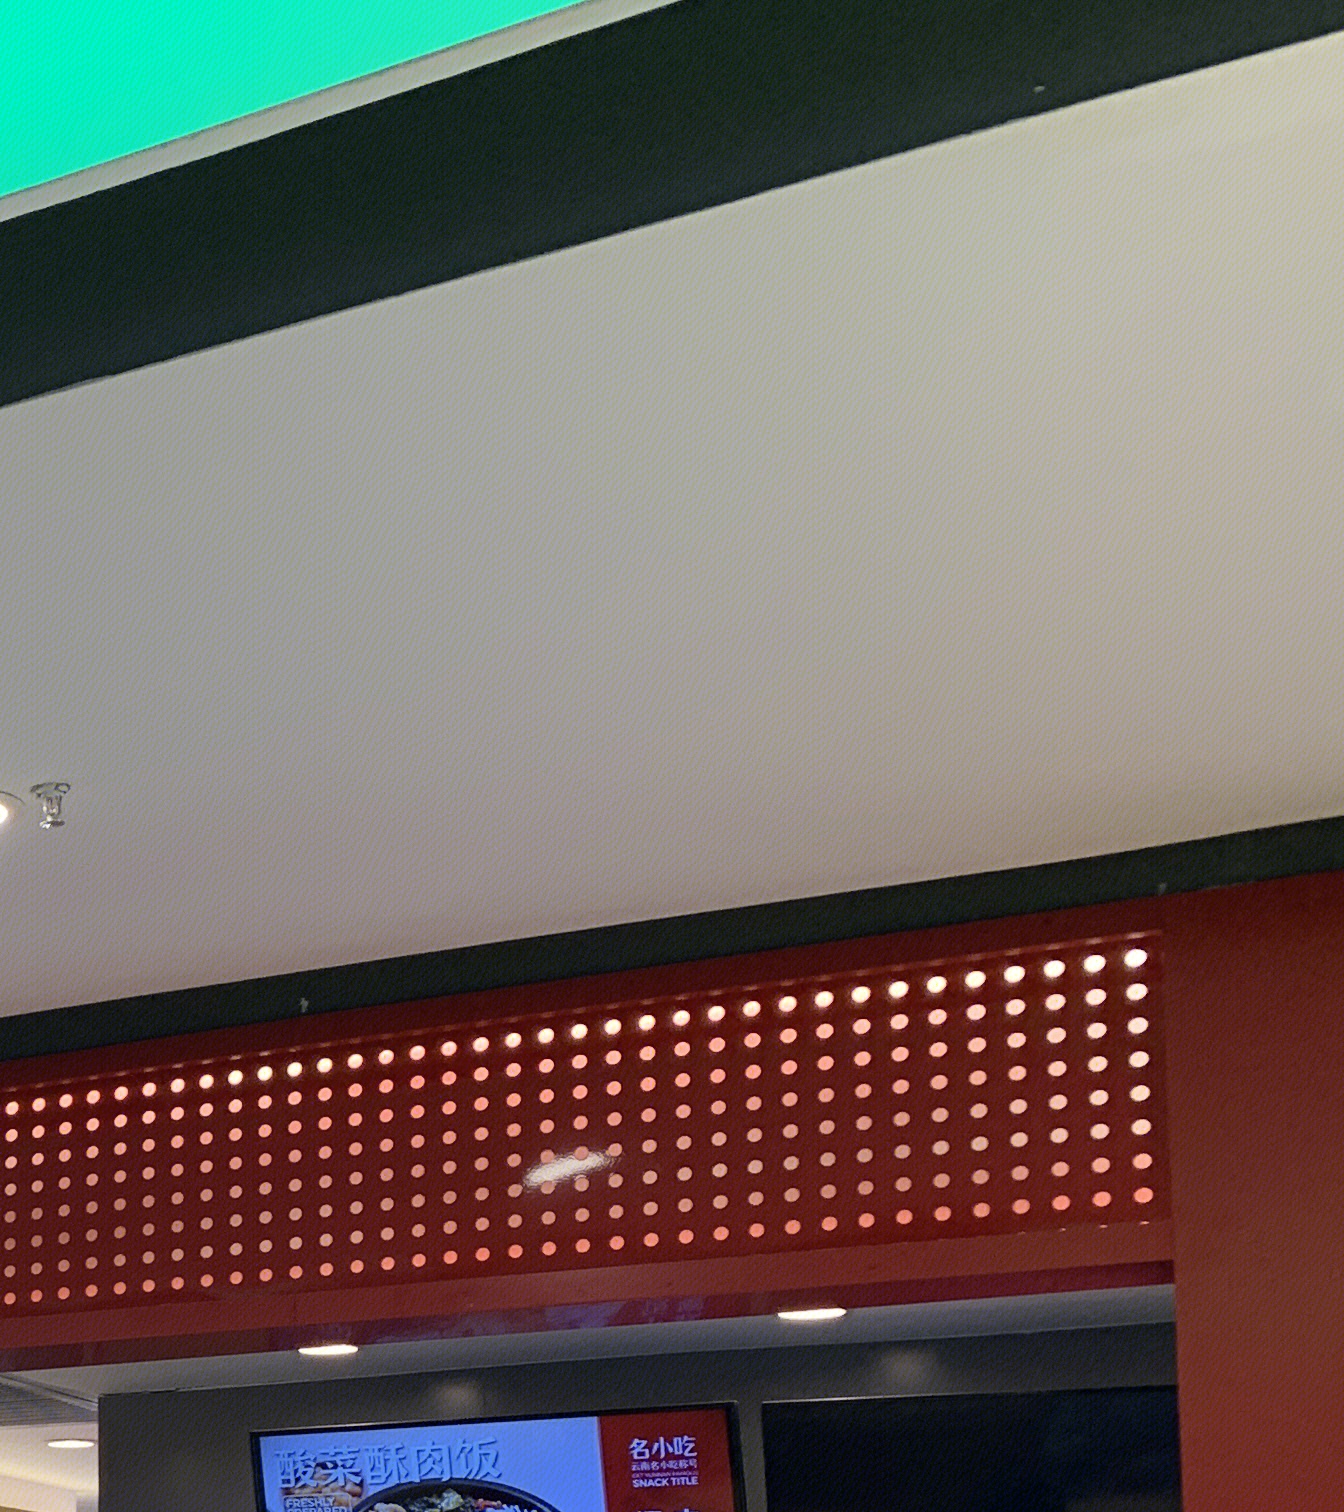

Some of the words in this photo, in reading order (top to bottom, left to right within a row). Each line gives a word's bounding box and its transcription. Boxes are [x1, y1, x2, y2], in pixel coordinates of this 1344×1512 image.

[629, 1435, 697, 1460] 名小吃
[275, 1436, 503, 1488] 酸菜酥肉饭
[632, 1478, 669, 1487] SNACK
[671, 1476, 699, 1486] TITLE
[286, 1496, 336, 1508] FRESHLY
